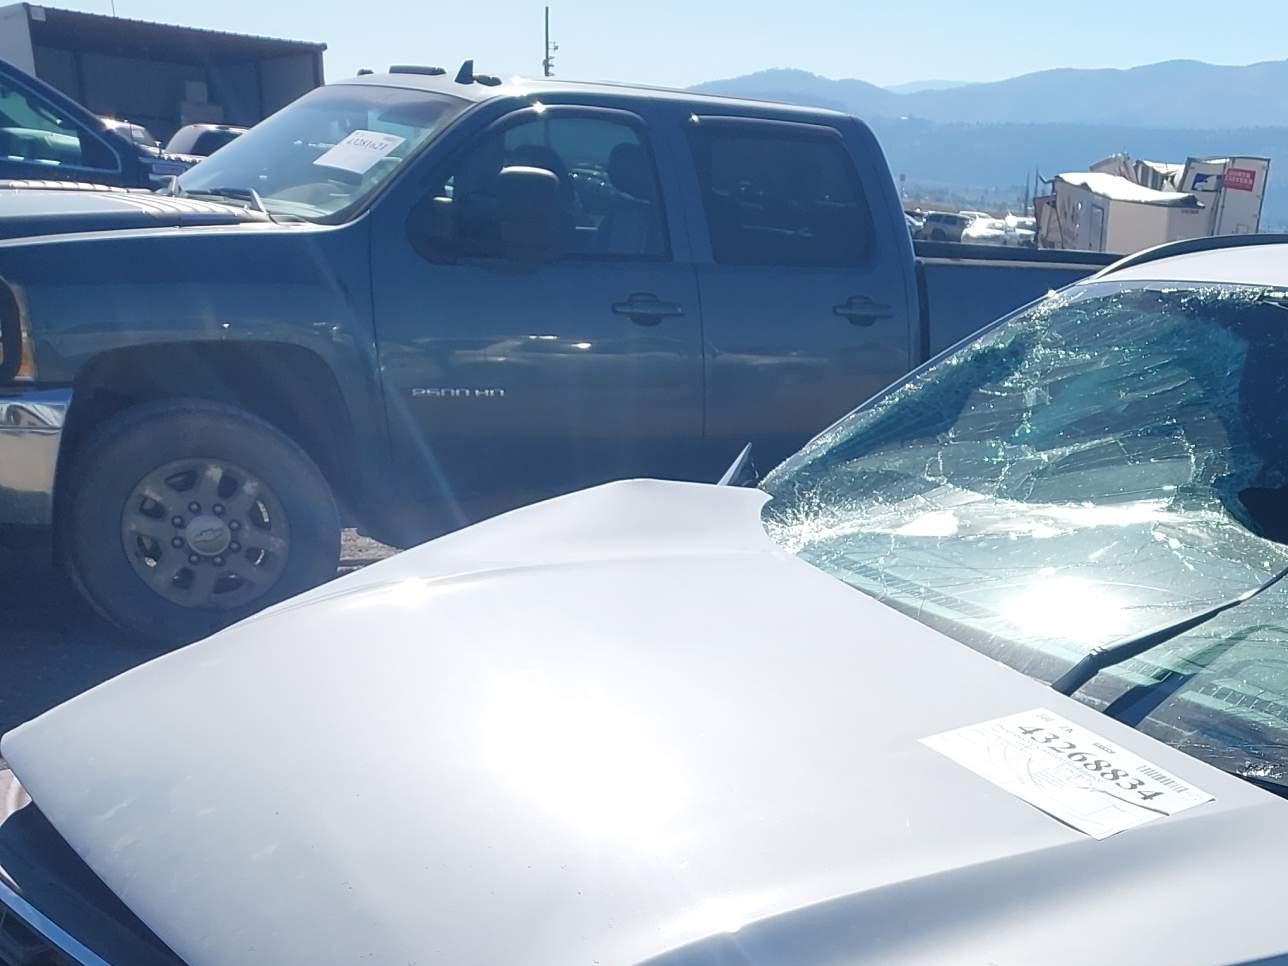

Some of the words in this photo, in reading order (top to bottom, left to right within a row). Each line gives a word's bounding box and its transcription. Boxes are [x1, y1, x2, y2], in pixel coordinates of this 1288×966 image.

[412, 388, 468, 397] 2500
[475, 388, 504, 397] HD
[1018, 725, 1164, 801] 43268834
